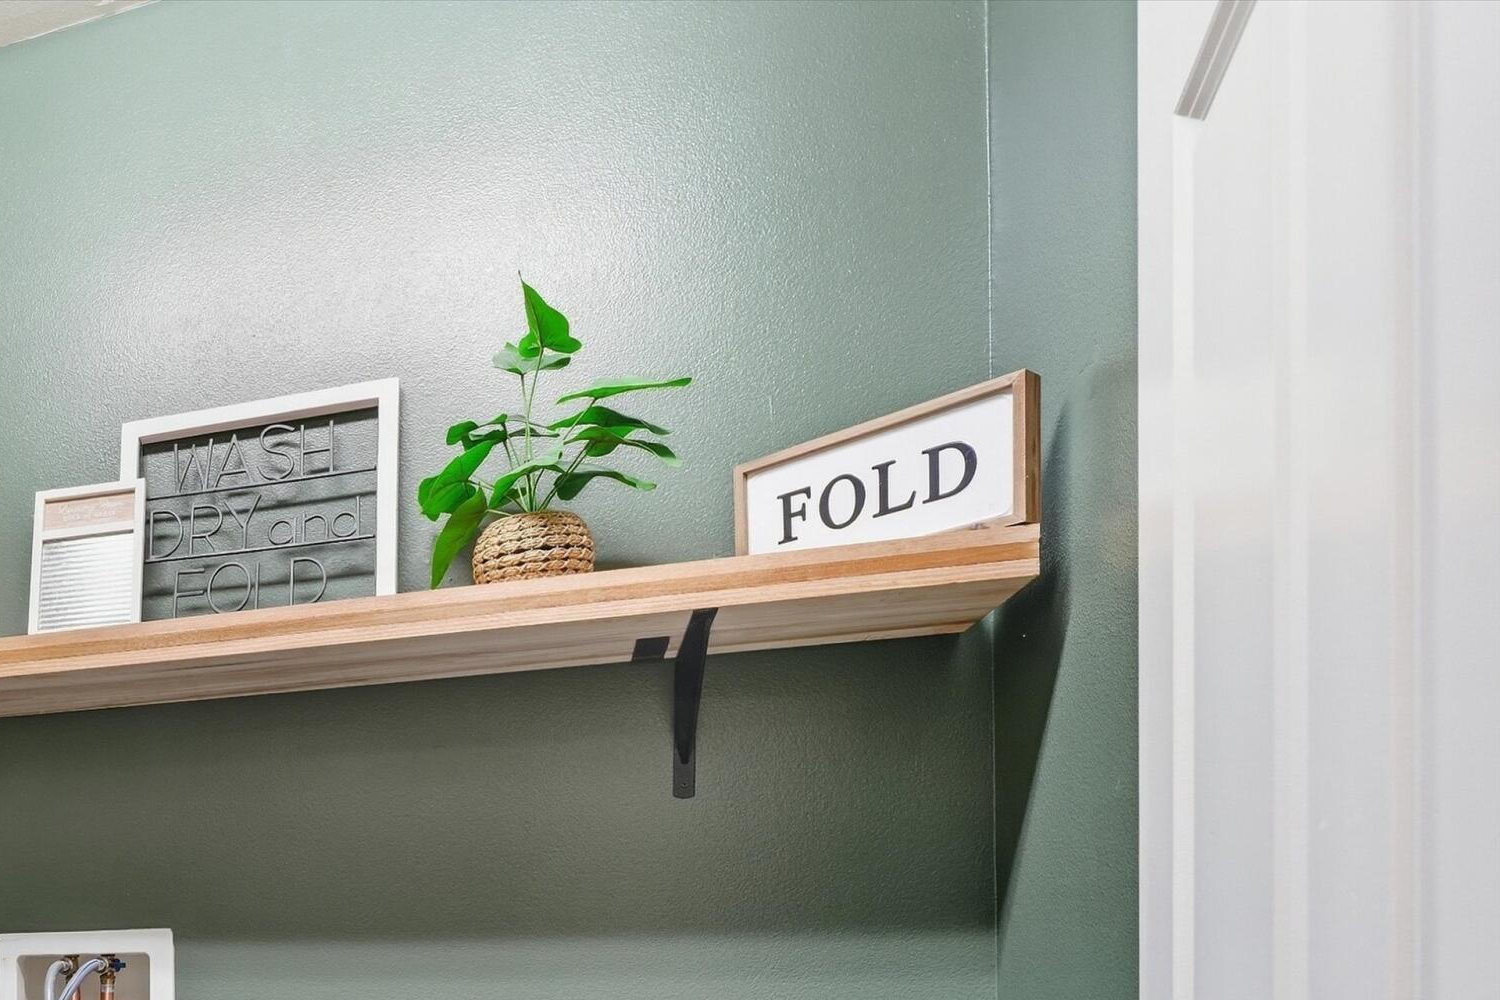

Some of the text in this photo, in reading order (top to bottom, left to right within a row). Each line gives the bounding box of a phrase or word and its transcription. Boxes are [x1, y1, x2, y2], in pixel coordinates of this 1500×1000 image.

[173, 420, 335, 494] WASH
[149, 494, 363, 560] DRY and
[776, 440, 978, 546] FOLD
[173, 556, 328, 619] FOLD
